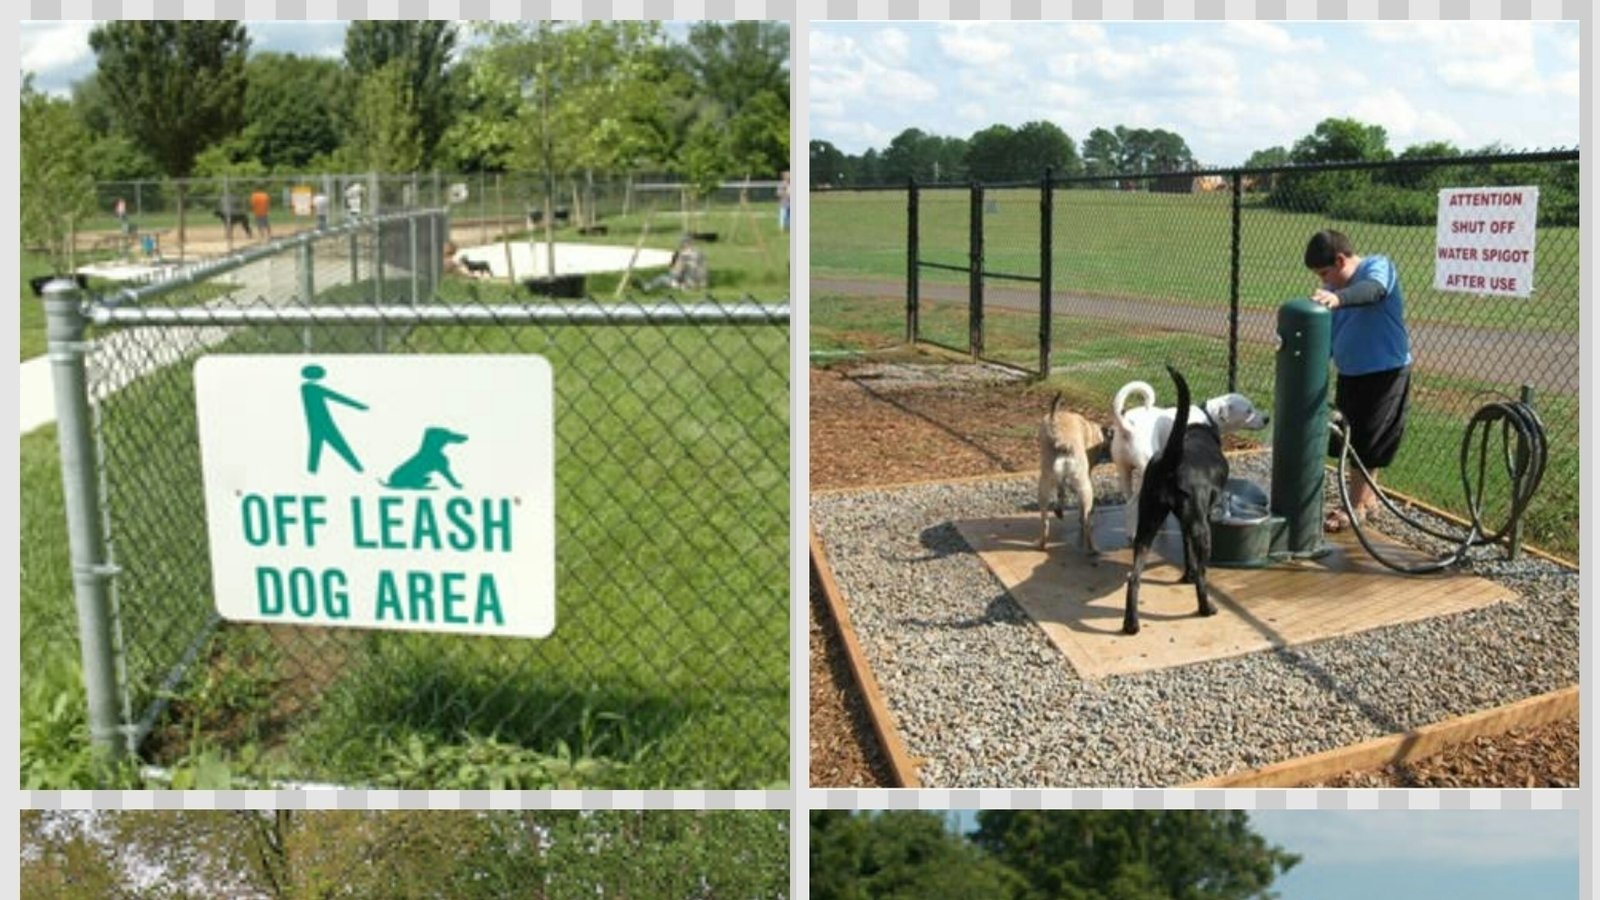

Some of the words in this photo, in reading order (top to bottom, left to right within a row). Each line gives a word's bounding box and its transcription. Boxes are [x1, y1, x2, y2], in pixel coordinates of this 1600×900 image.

[1449, 192, 1523, 207] ATTENTION
[1451, 220, 1486, 234] SHUT
[1490, 220, 1516, 234] OFF
[1438, 247, 1478, 261] WATER
[1482, 248, 1530, 263] SPIGOT
[1446, 274, 1486, 289] AFTER
[1490, 277, 1517, 292] USE
[241, 494, 327, 548] OFF
[350, 496, 512, 553] LEASH
[255, 566, 350, 620] DOG
[375, 569, 505, 626] AREA
